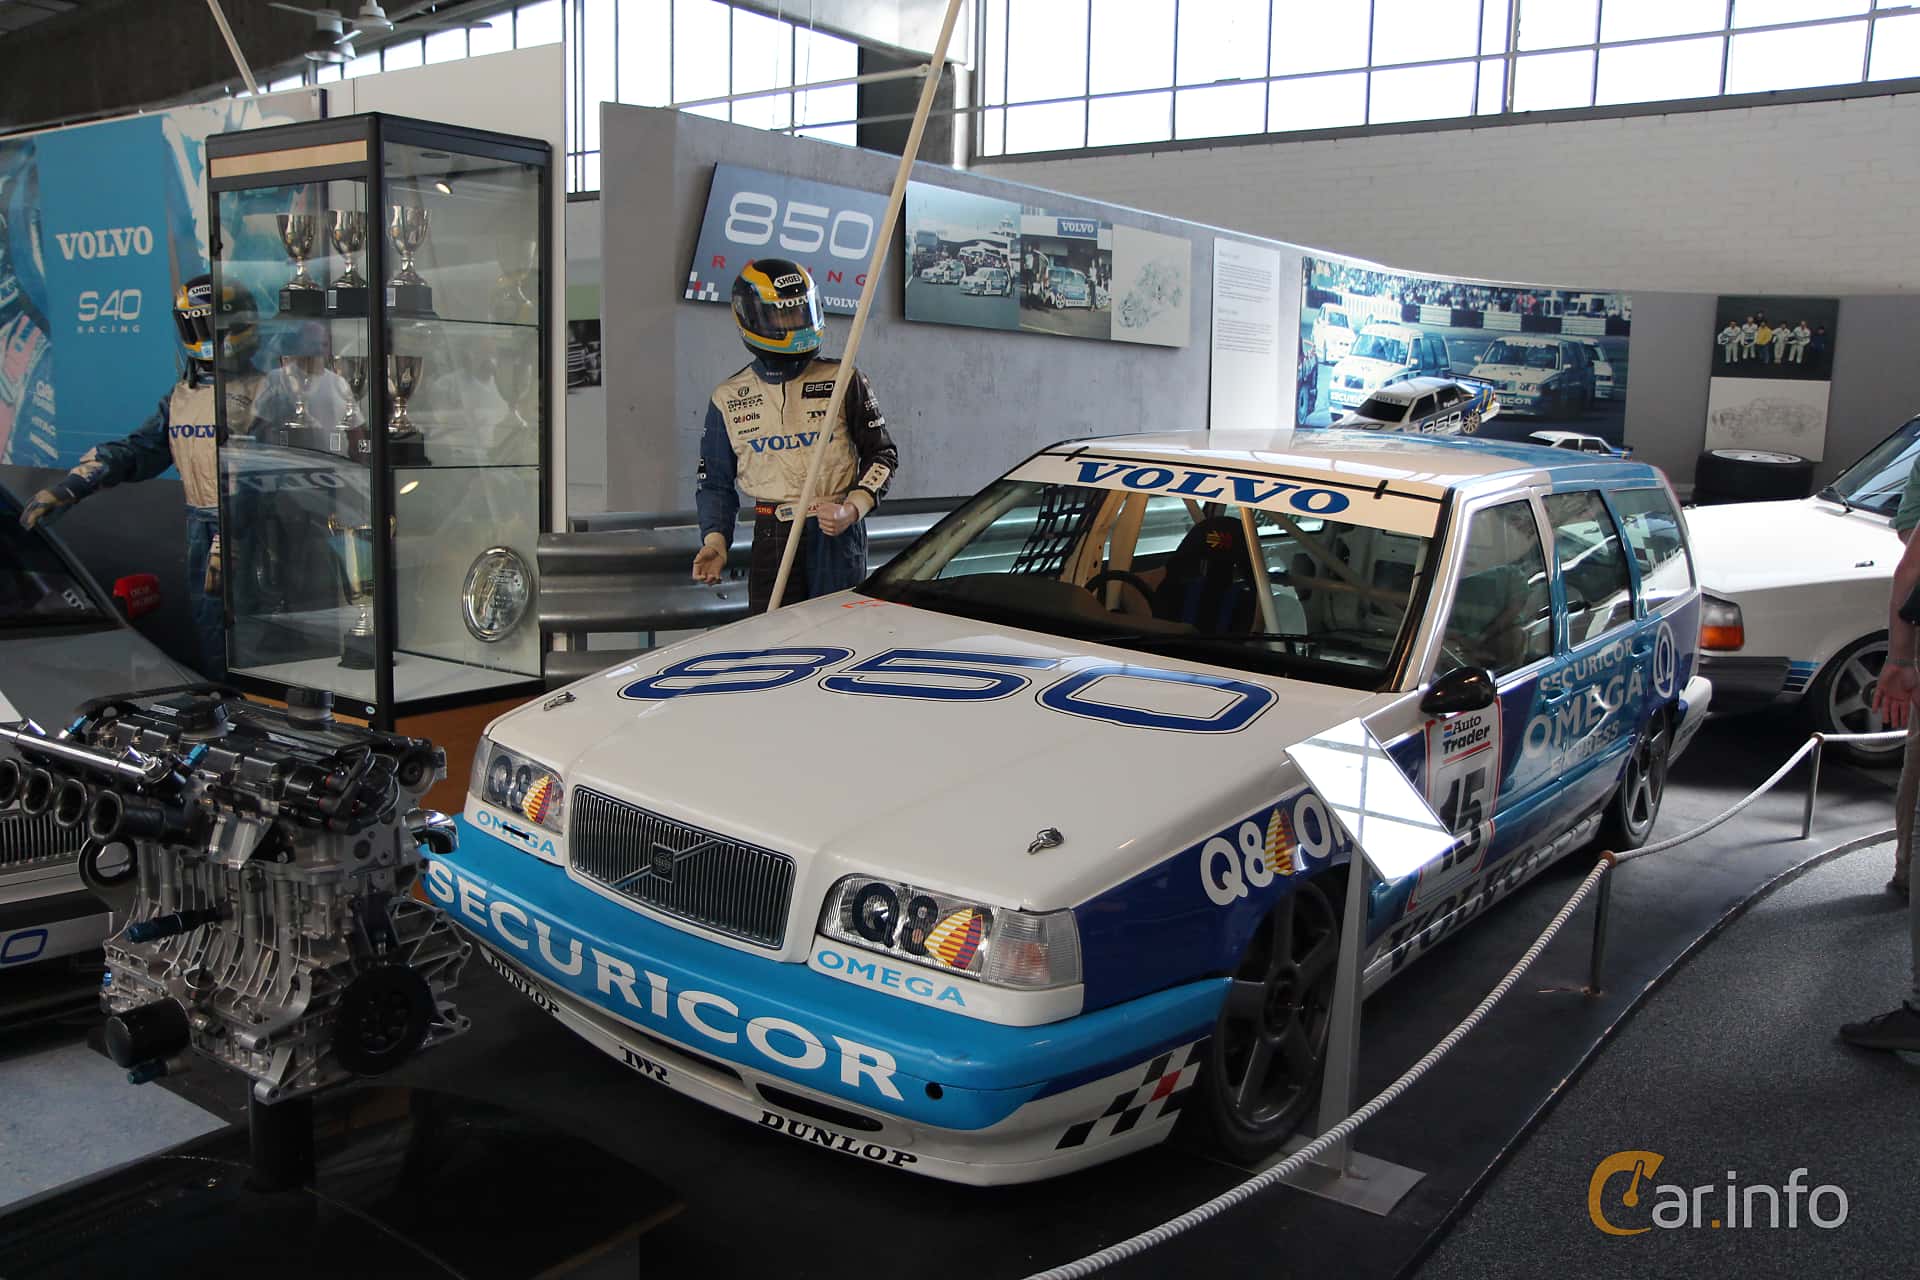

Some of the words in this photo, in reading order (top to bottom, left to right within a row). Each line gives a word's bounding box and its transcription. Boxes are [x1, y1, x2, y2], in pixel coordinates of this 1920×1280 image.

[56, 226, 153, 260] VOLVO
[724, 191, 874, 260] 850
[1061, 221, 1094, 233] VOLVO
[78, 289, 142, 321] S40
[773, 295, 810, 309] VOLV
[777, 275, 800, 287] SHOEI
[76, 324, 141, 333] RACING
[805, 384, 834, 396] 850
[168, 424, 217, 438] VOLV
[1076, 461, 1350, 515] VOLVO
[1540, 638, 1634, 691] SECURICOR
[617, 646, 1279, 734] 850
[1522, 670, 1643, 758] OMEGA
[1442, 724, 1490, 754] Trader
[1452, 715, 1482, 734] Auto
[476, 810, 556, 857] OMEGA
[1440, 767, 1487, 873] 15
[1200, 820, 1274, 906] Q8
[849, 881, 939, 956] Q8
[426, 859, 904, 1101] SECURICOR
[488, 955, 560, 1017] DUNLOP
[817, 949, 966, 1007] OMEGA
[618, 1045, 671, 1084] TWR
[758, 1110, 918, 1168] DUNLOP
